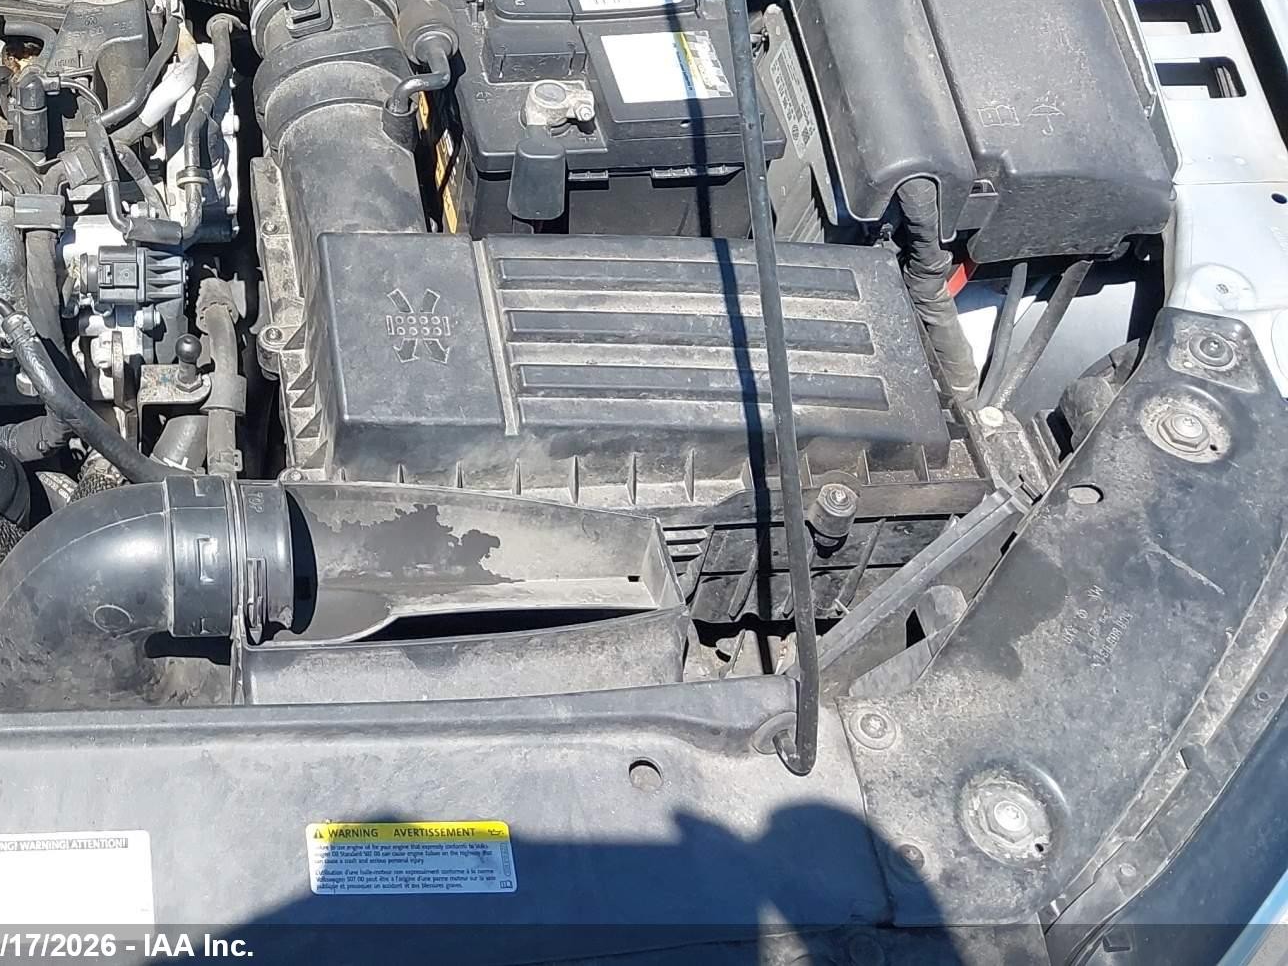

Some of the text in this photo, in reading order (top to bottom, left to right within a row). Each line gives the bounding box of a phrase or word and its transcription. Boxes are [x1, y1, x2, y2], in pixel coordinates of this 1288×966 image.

[328, 827, 476, 838] WARNING AVERTISSEMENT
[19, 840, 69, 851] WARNING!
[70, 838, 127, 850] ATTENTION!
